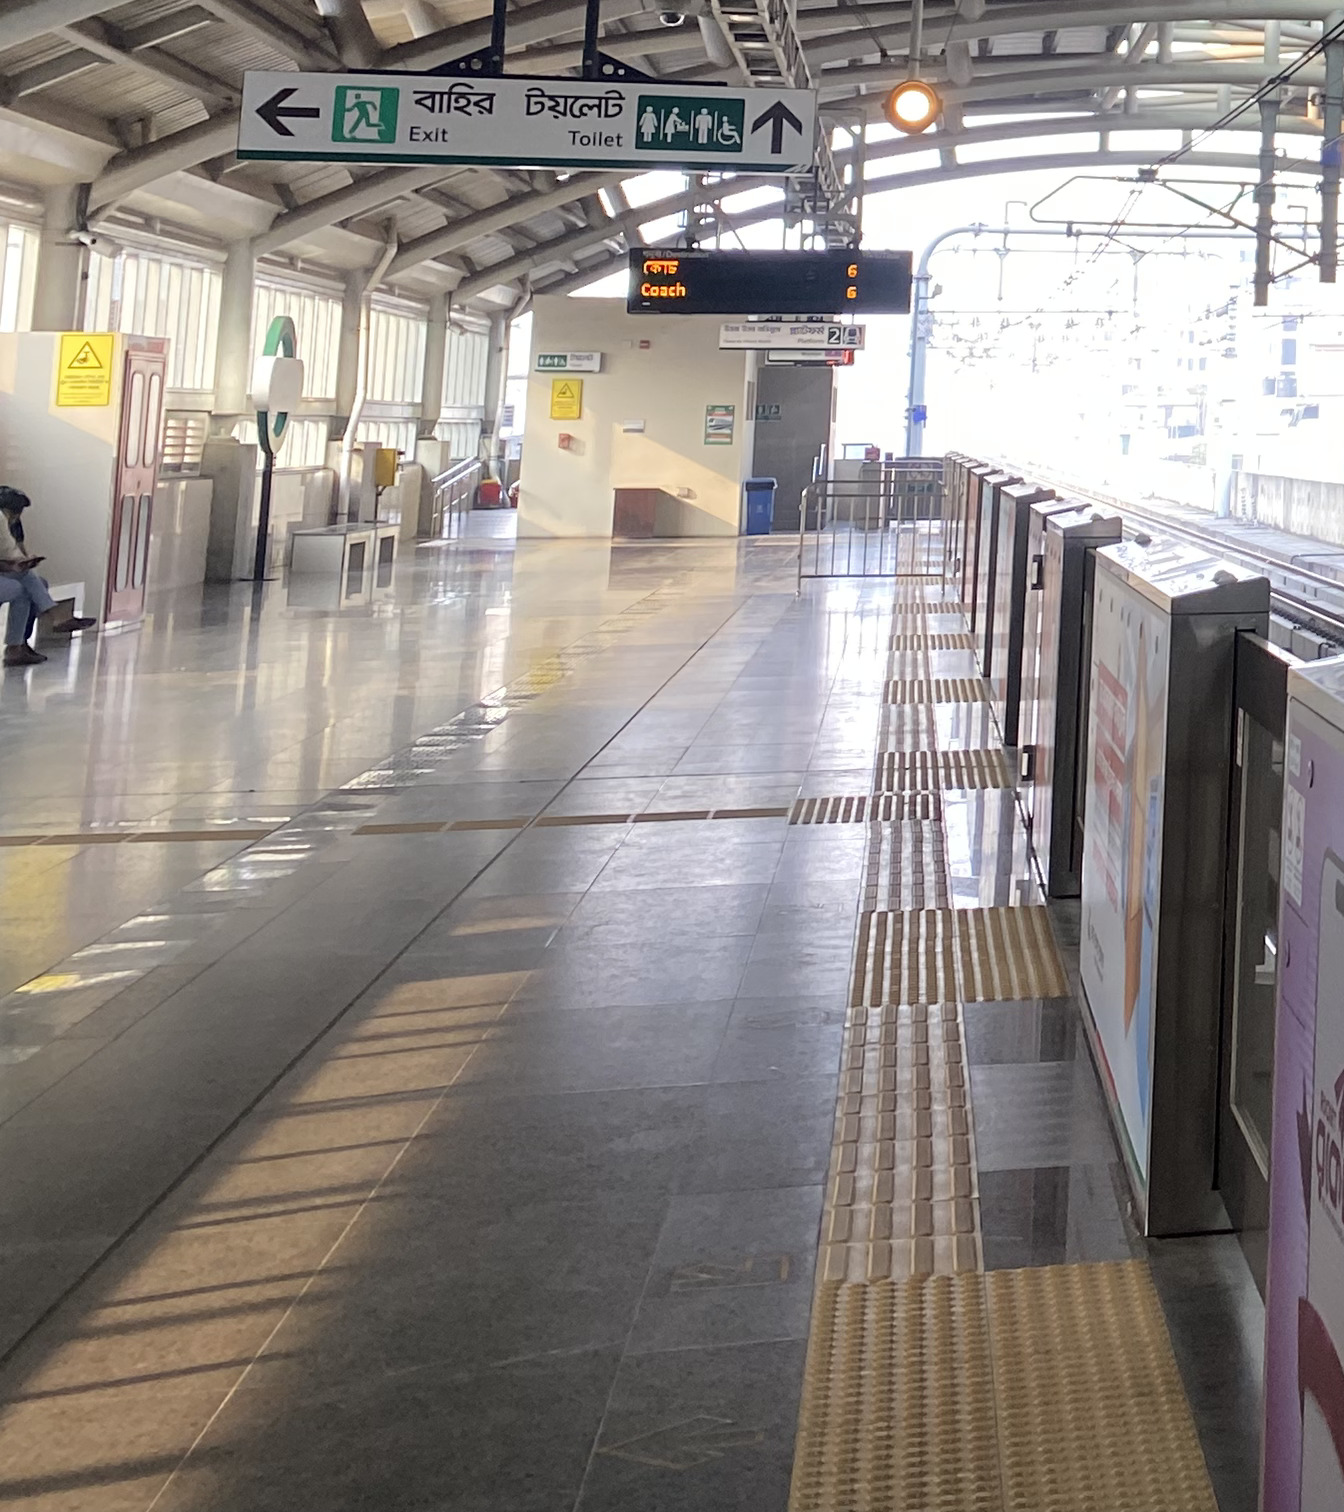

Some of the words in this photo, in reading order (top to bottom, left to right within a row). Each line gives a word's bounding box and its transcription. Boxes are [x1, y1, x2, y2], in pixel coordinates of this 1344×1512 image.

[413, 82, 496, 117] বাহির
[525, 87, 625, 119] টয়লেট
[409, 126, 448, 143] Exit
[568, 130, 623, 147] Toilet
[643, 260, 679, 276] কোচ
[641, 282, 686, 297] Coach
[829, 328, 840, 344] 2
